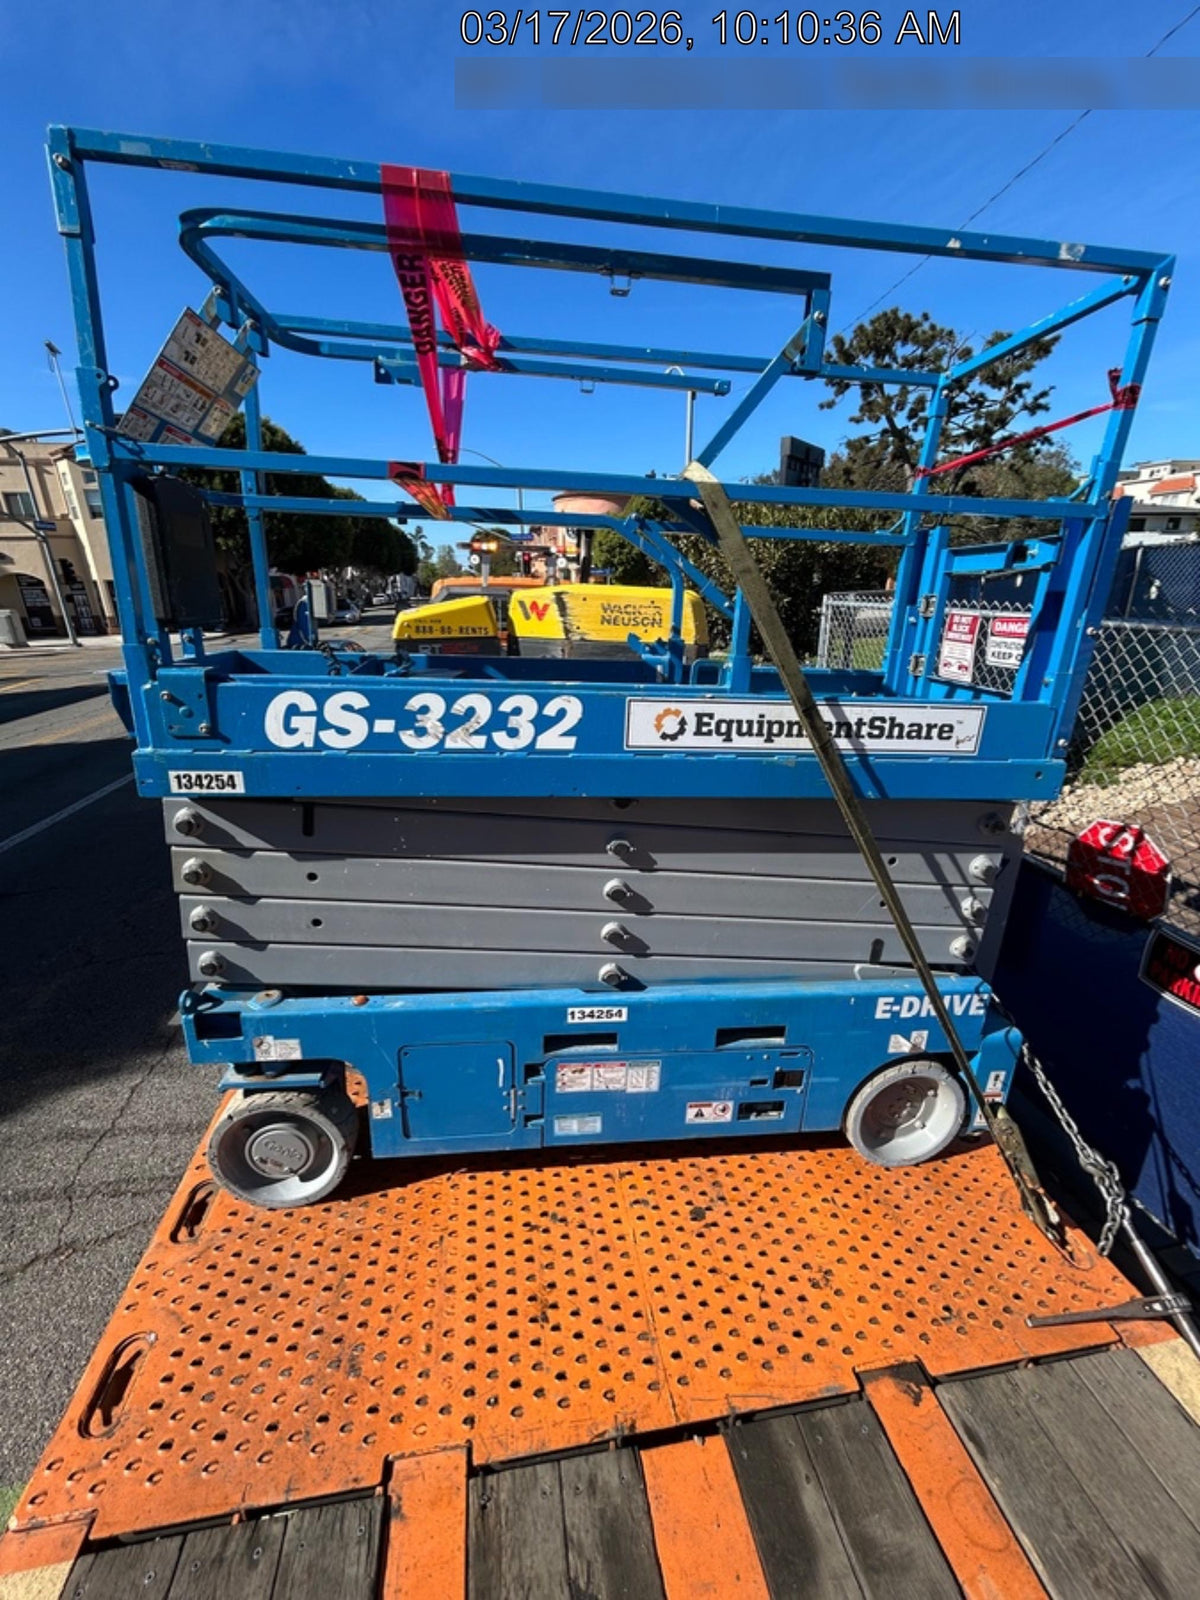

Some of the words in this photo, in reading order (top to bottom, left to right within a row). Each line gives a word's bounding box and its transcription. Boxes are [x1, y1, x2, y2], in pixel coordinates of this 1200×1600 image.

[397, 253, 437, 356] DANGER
[600, 615, 662, 628] NEUSON
[994, 621, 1030, 634] DANGE
[991, 650, 1014, 660] KEEP
[264, 690, 583, 750] GS-3232
[174, 773, 237, 790] 134254
[568, 1009, 623, 1021] 134254
